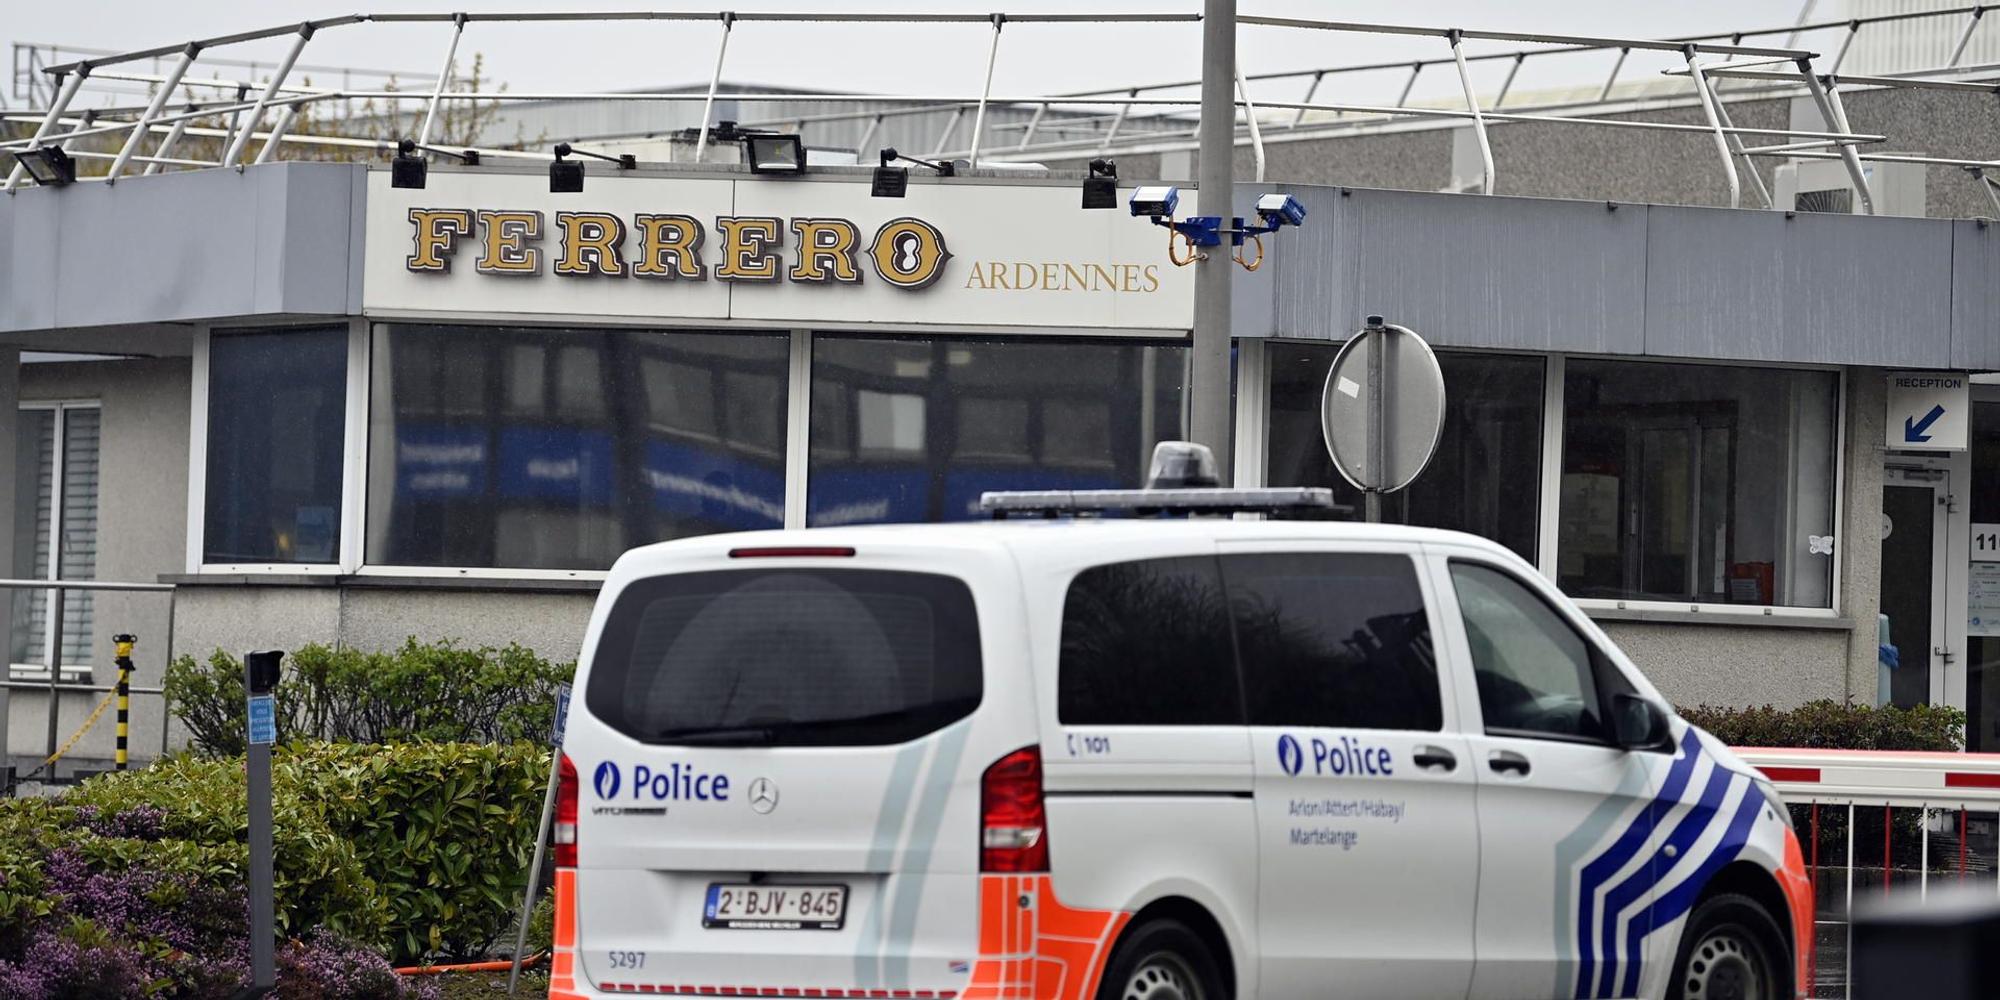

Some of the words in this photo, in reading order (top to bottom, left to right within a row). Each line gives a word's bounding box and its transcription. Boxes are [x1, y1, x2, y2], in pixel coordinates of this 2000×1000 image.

[406, 207, 955, 292] FERRERO
[963, 261, 1161, 293] ARDENNES
[1895, 378, 1961, 389] RECEPTION
[1975, 533, 2000, 551] 11
[1084, 737, 1111, 754] 101
[1311, 735, 1394, 776] Police
[633, 763, 729, 801] Police
[1290, 828, 1359, 850] Martelange
[608, 950, 646, 969] 5297
